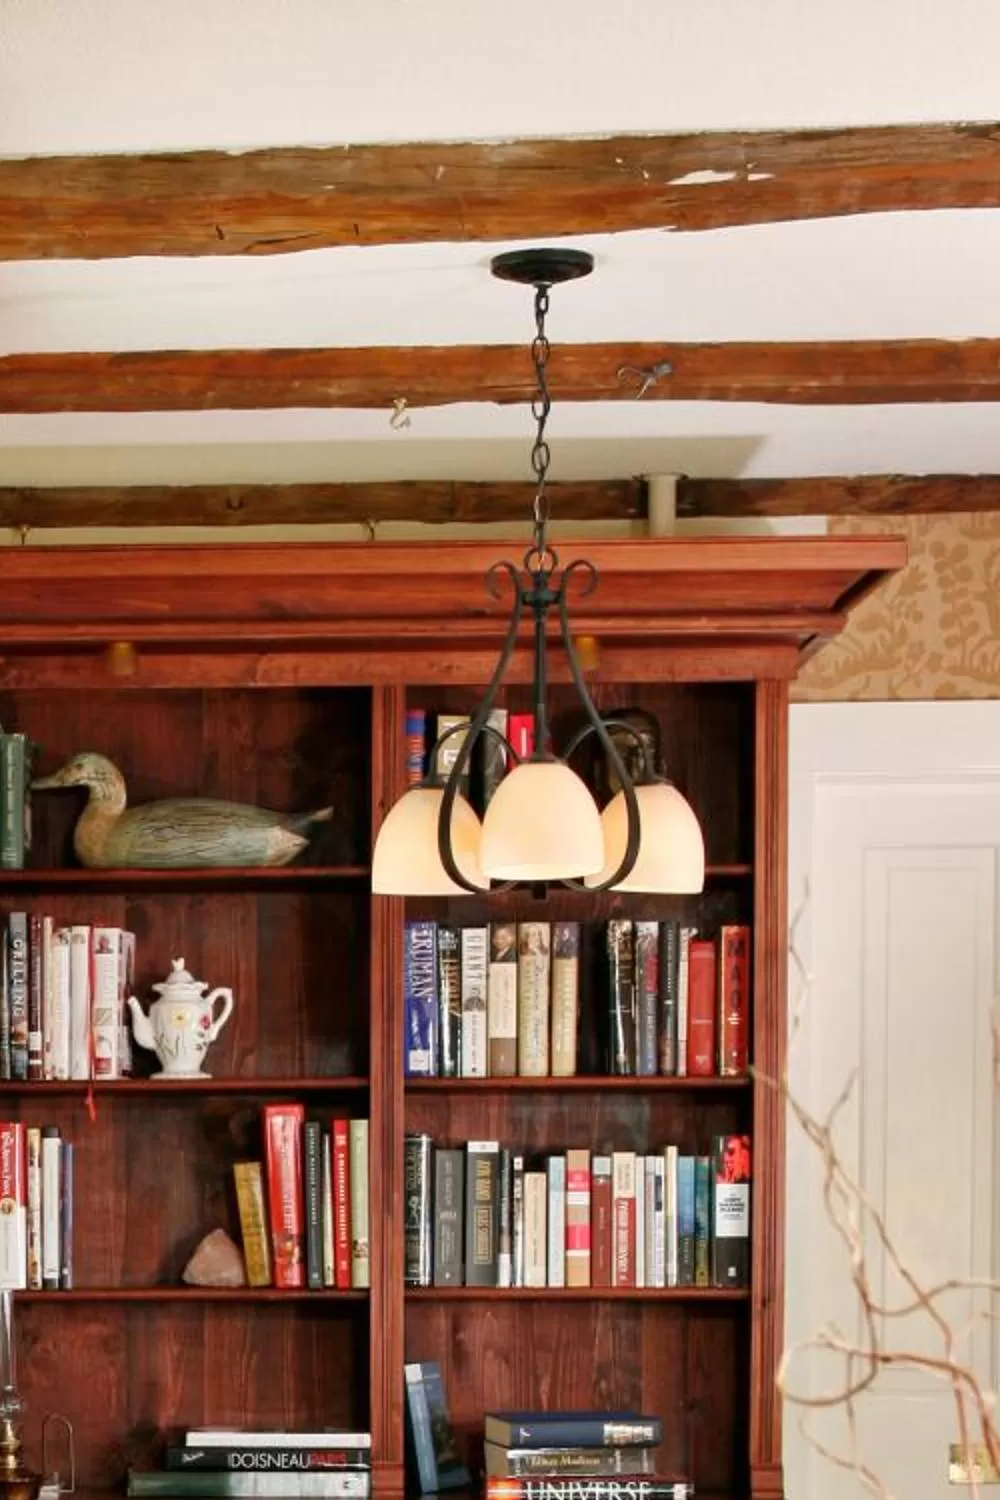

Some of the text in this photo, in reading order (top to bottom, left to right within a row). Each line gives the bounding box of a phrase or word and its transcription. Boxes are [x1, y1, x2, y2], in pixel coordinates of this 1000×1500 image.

[12, 938, 26, 1017] GRILLING
[410, 928, 433, 997] TRUMAN
[228, 1452, 312, 1469] DOISNEAU
